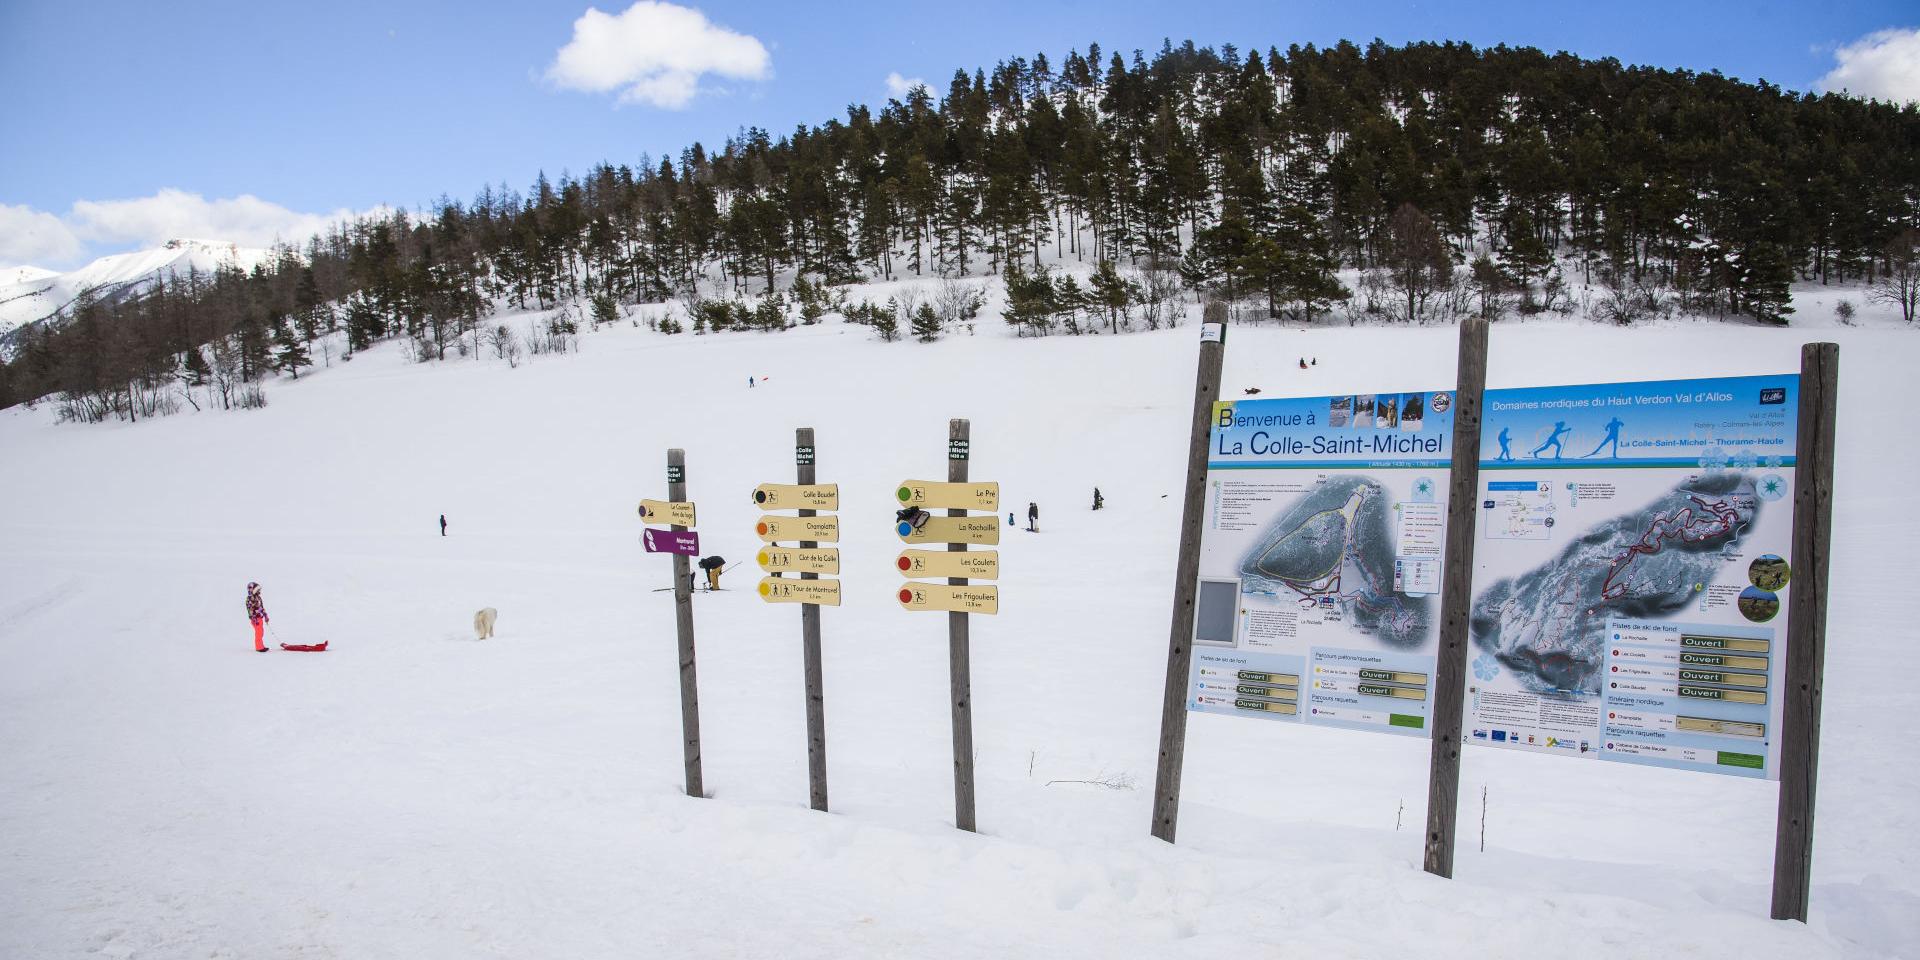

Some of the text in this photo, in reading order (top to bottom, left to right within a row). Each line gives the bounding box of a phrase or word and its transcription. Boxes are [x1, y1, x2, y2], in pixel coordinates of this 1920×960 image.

[1492, 392, 1733, 411] Domaines nordiques du Haut Verdon Val d'Allos
[1219, 409, 1316, 428] Bienvenue à
[1219, 431, 1443, 456] La Colle-Saint-Michel
[1620, 440, 1631, 448] La
[1631, 438, 1707, 448] Colle-Saint-Michel
[1716, 437, 1784, 447] Thorame-Haute
[817, 491, 836, 499] Baudet
[985, 489, 996, 498] Pré
[968, 523, 996, 531] Rochaille
[823, 555, 837, 563] Colle
[960, 558, 996, 566] Les Coulets
[952, 592, 995, 602] Les Frigouliers
[1612, 622, 1632, 630] Pistes
[1685, 638, 1722, 647] Ouvert
[1315, 652, 1337, 660] Parcours
[1684, 655, 1720, 664] Ouvert
[1240, 673, 1265, 681] Ouvert
[1361, 670, 1390, 680] Ouvert
[1682, 672, 1719, 681] Ouvert
[1239, 686, 1264, 695] Ouvert
[1360, 685, 1388, 695] Ouvert
[1682, 688, 1719, 697] Ouvert
[1312, 694, 1334, 702] Parcours
[1237, 700, 1263, 709] Ouvert
[1636, 699, 1664, 707] nordique
[1606, 726, 1666, 739] Parcours raquettes
